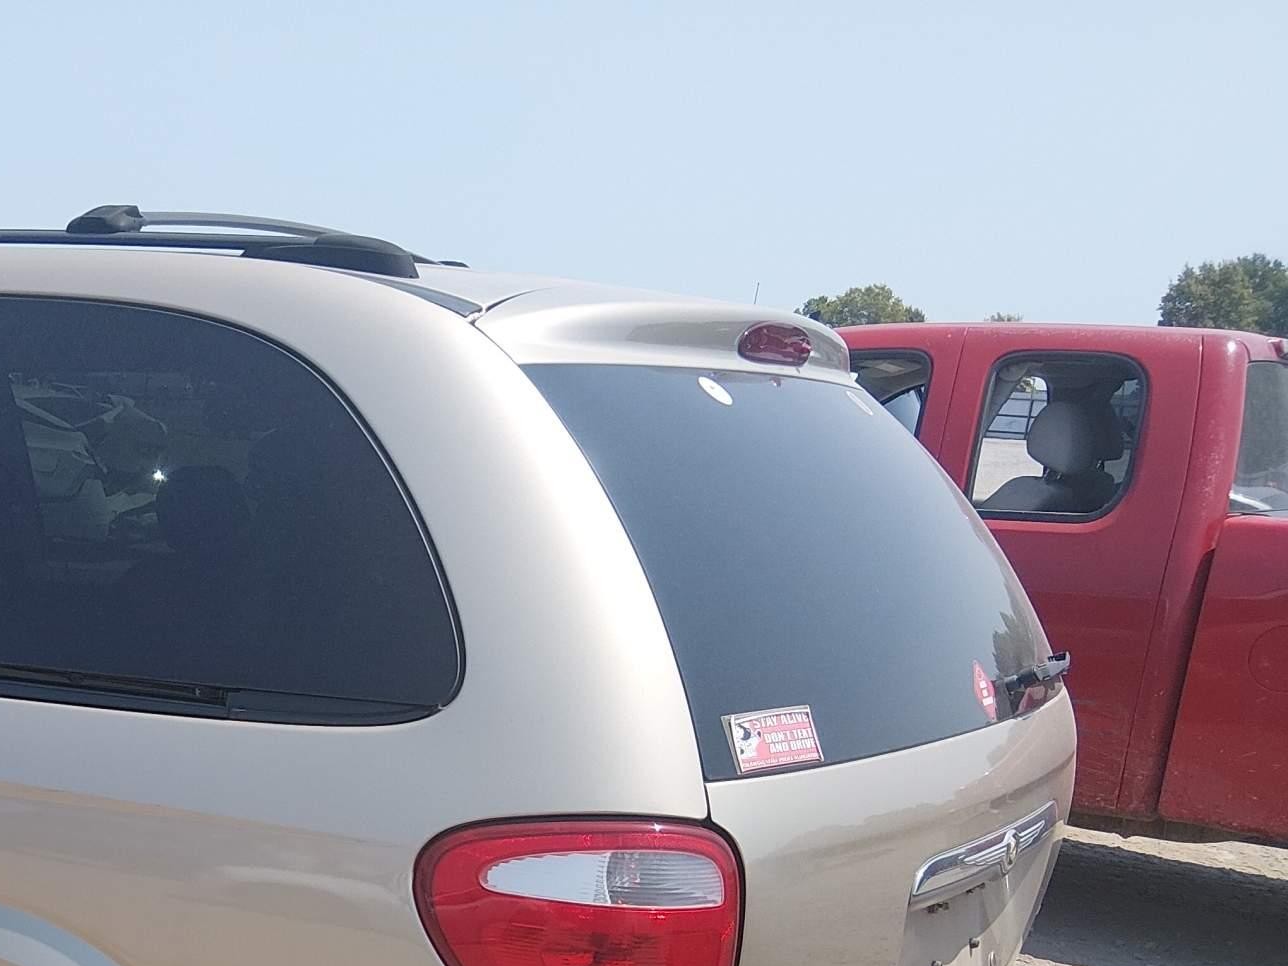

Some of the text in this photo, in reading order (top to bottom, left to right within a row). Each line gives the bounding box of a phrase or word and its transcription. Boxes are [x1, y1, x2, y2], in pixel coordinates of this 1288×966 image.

[753, 712, 809, 728] STAY ALIVE
[794, 727, 812, 740] TEXT
[770, 739, 816, 753] AND DRIVE
